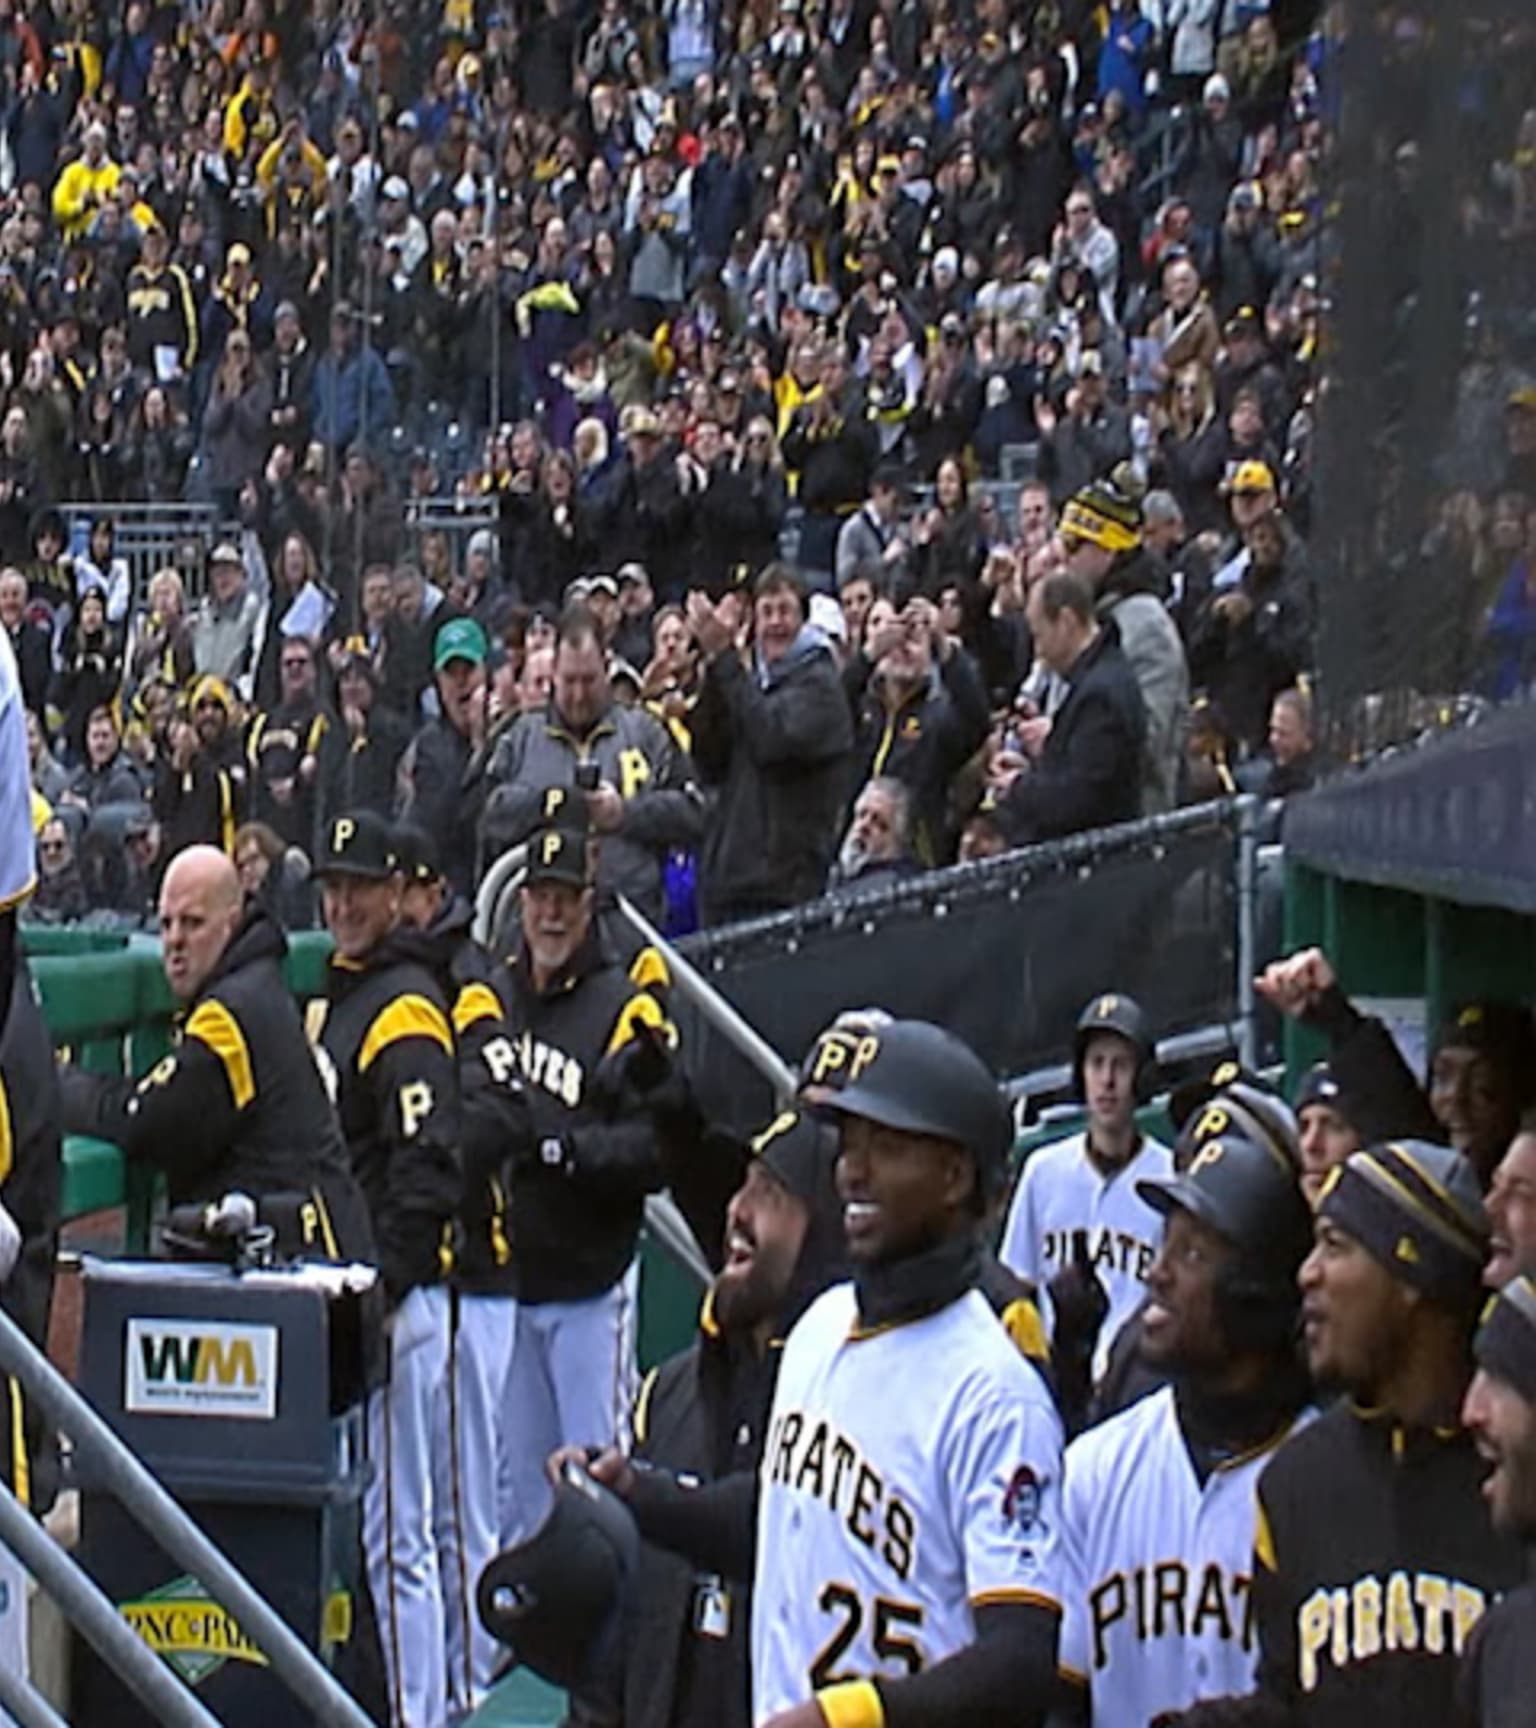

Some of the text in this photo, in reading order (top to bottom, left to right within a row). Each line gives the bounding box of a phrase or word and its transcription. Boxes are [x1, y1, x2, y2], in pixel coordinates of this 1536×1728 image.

[620, 747, 650, 800] P
[544, 788, 564, 817] P
[333, 817, 355, 853] P
[543, 832, 562, 865] P
[814, 1041, 847, 1081] P
[851, 1035, 878, 1080] P
[1212, 1061, 1240, 1087] P
[400, 1080, 433, 1137] P
[1193, 1107, 1231, 1143] P
[1190, 1138, 1225, 1176] P
[1043, 1227, 1157, 1281] PIRATE
[139, 1333, 258, 1387] WM
[809, 1581, 924, 1691] 25
[1089, 1560, 1253, 1671] PIRAT
[1298, 1569, 1486, 1692] PIRATE
